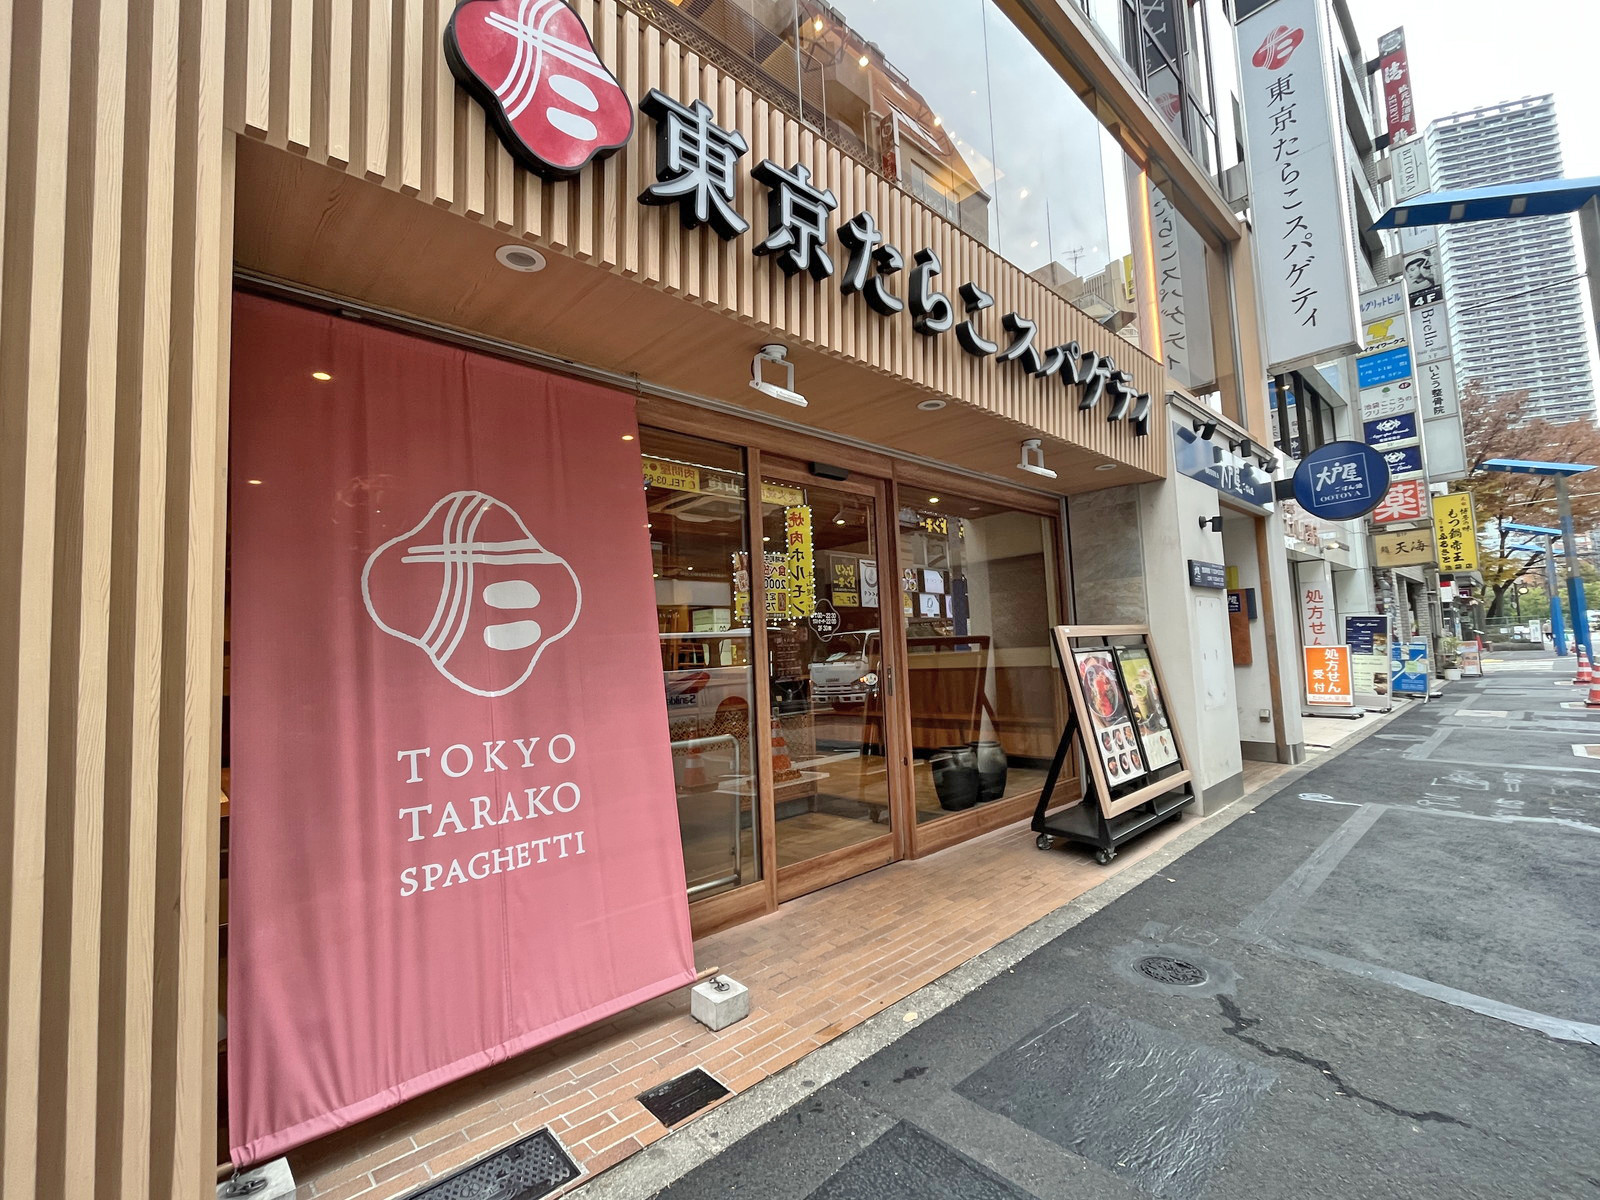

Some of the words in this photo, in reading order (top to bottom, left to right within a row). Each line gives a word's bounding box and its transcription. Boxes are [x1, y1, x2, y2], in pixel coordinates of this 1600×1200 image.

[1388, 94, 1399, 124] SEIRYU
[1402, 148, 1416, 192] BITORIA
[1266, 73, 1318, 327] 東京たらこスパゲティ
[640, 88, 1152, 436] 東京たらこスパゲティ
[1414, 292, 1436, 307] 4F
[1421, 307, 1438, 348] Brella
[1364, 404, 1406, 418] クリニック
[1429, 364, 1446, 416] いとう整骨院
[1315, 462, 1363, 492] 大戸屋
[1320, 490, 1362, 502] OOTOYA
[1375, 484, 1418, 521] 薬
[1395, 539, 1430, 555] 天海
[1448, 509, 1465, 562] もつ鍋帝王
[1312, 669, 1325, 693] 受付
[1324, 648, 1341, 693] 処方せん
[397, 733, 576, 784] TOKYO
[398, 782, 581, 842] TARAKO
[400, 831, 586, 897] SPAGHETTI
